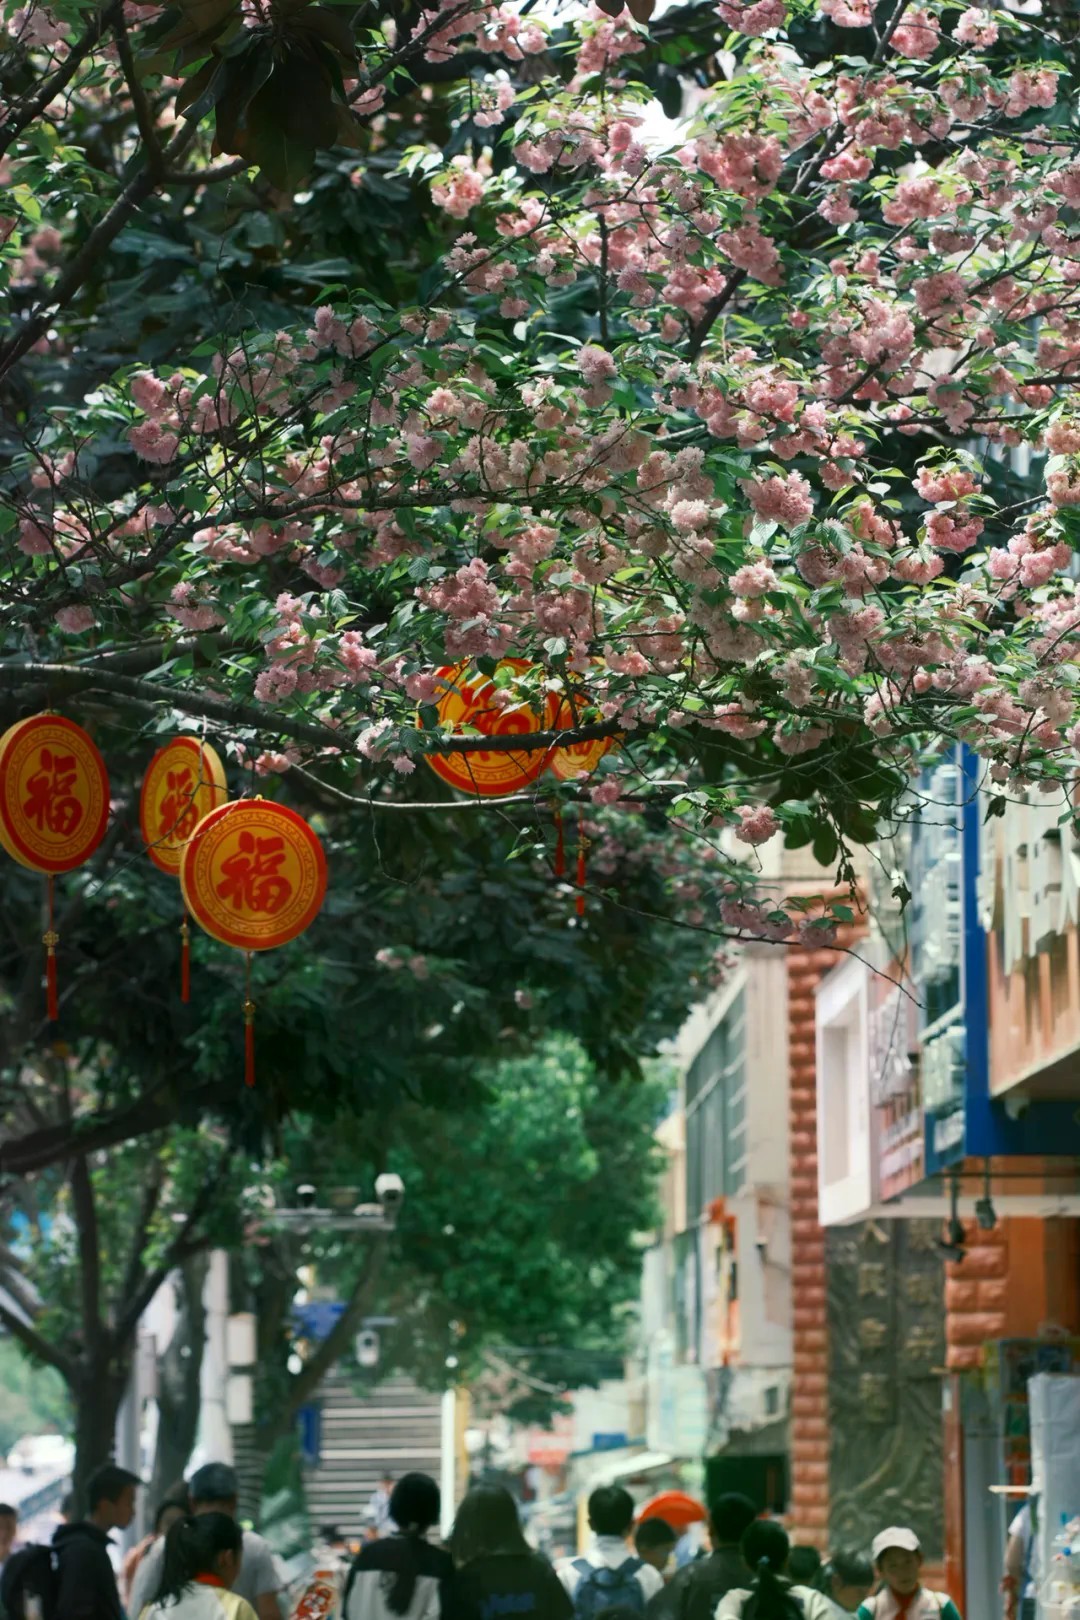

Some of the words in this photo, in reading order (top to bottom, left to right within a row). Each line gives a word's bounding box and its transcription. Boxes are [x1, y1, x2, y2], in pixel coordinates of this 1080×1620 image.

[24, 750, 84, 836] 福
[160, 768, 198, 842] 福
[218, 832, 292, 914] 福
